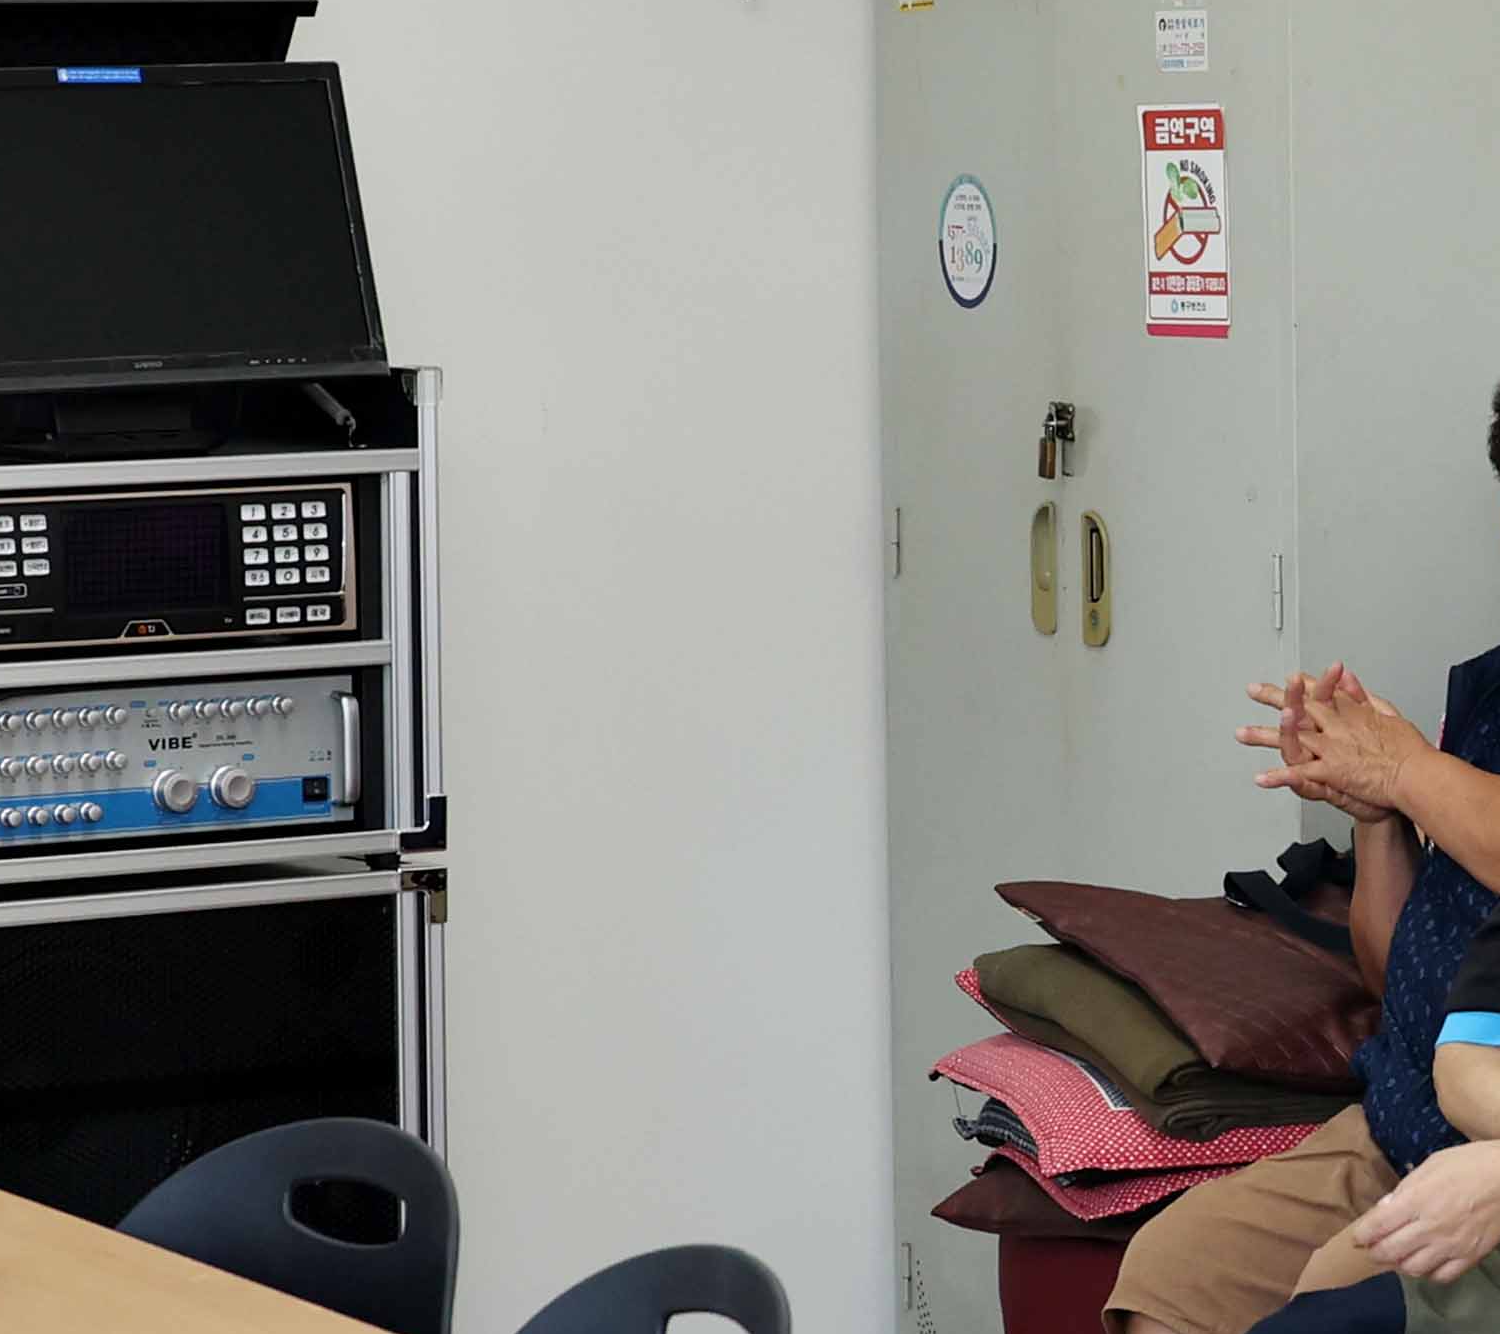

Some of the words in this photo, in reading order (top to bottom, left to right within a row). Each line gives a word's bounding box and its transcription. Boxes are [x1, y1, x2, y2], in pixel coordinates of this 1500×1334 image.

[1155, 116, 1216, 145] 금연구역
[251, 507, 256, 518] 1
[280, 506, 287, 516] 2
[311, 504, 318, 515] 3
[252, 530, 259, 539] 4
[282, 528, 289, 538] 5
[312, 527, 319, 536] 6
[253, 550, 260, 561] 7
[283, 549, 291, 560] 8
[313, 548, 321, 558] 9
[284, 571, 293, 581] 0
[148, 736, 194, 751] VIBE
